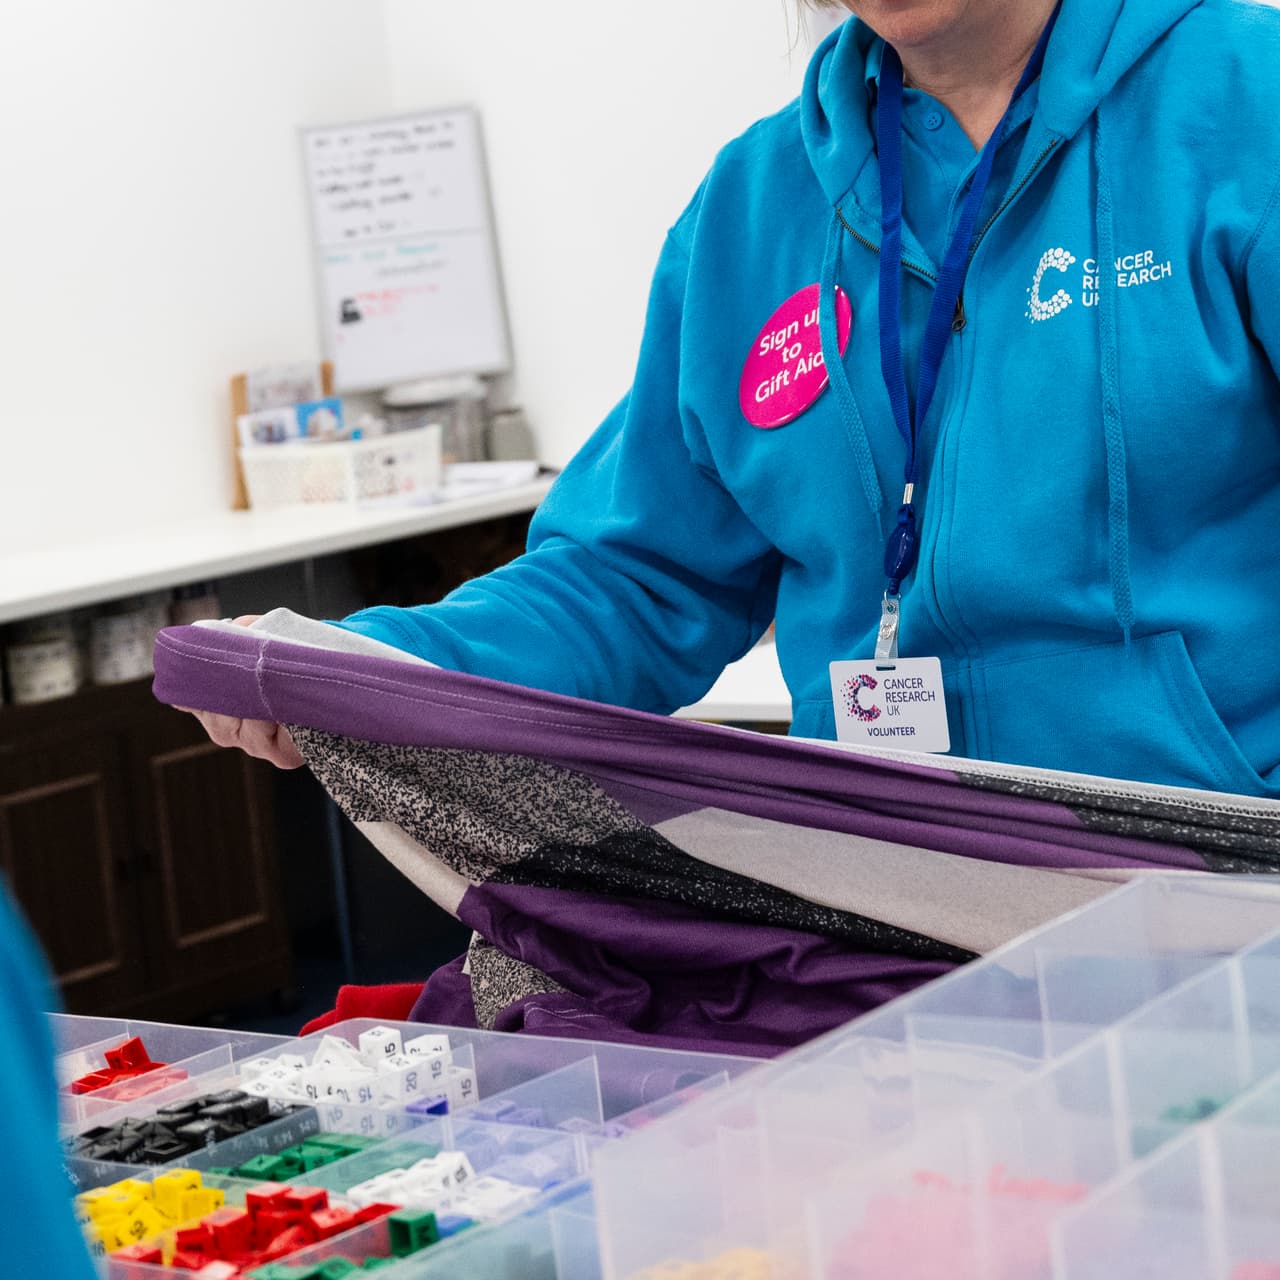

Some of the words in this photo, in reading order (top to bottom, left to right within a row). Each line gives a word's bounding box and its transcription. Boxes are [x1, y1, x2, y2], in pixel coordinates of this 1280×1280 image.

[1083, 249, 1154, 274] CNCER
[1082, 260, 1172, 290] REEARCH
[758, 320, 799, 356] Sign
[782, 342, 802, 363] to
[755, 369, 790, 403] Gift
[883, 677, 924, 690] CANCER
[885, 691, 936, 703] RESEARCH
[886, 705, 901, 716] UK
[867, 726, 916, 737] VOLUNTEER
